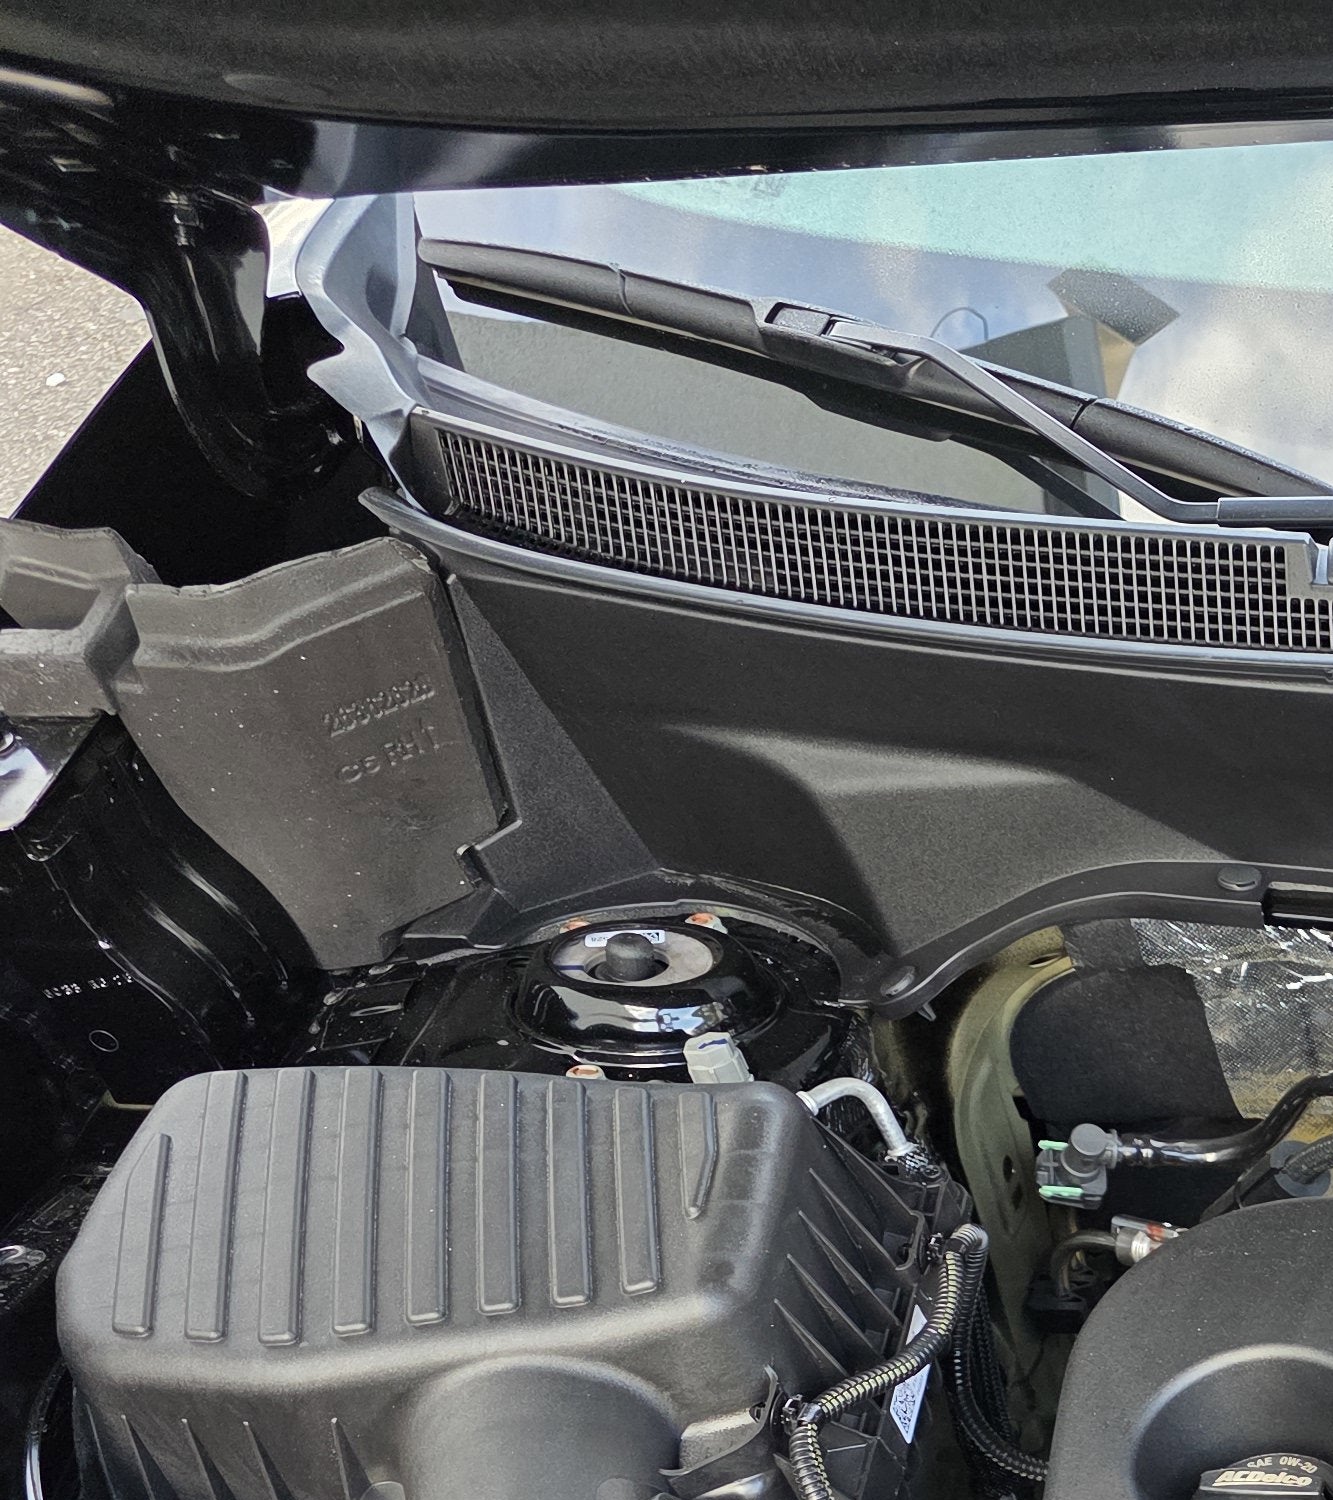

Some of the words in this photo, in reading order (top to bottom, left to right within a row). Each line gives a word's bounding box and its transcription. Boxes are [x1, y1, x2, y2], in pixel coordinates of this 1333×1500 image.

[1246, 1456, 1273, 1469] SAE
[1279, 1455, 1318, 1474] 0W-20
[1213, 1470, 1313, 1488] ACDelco
